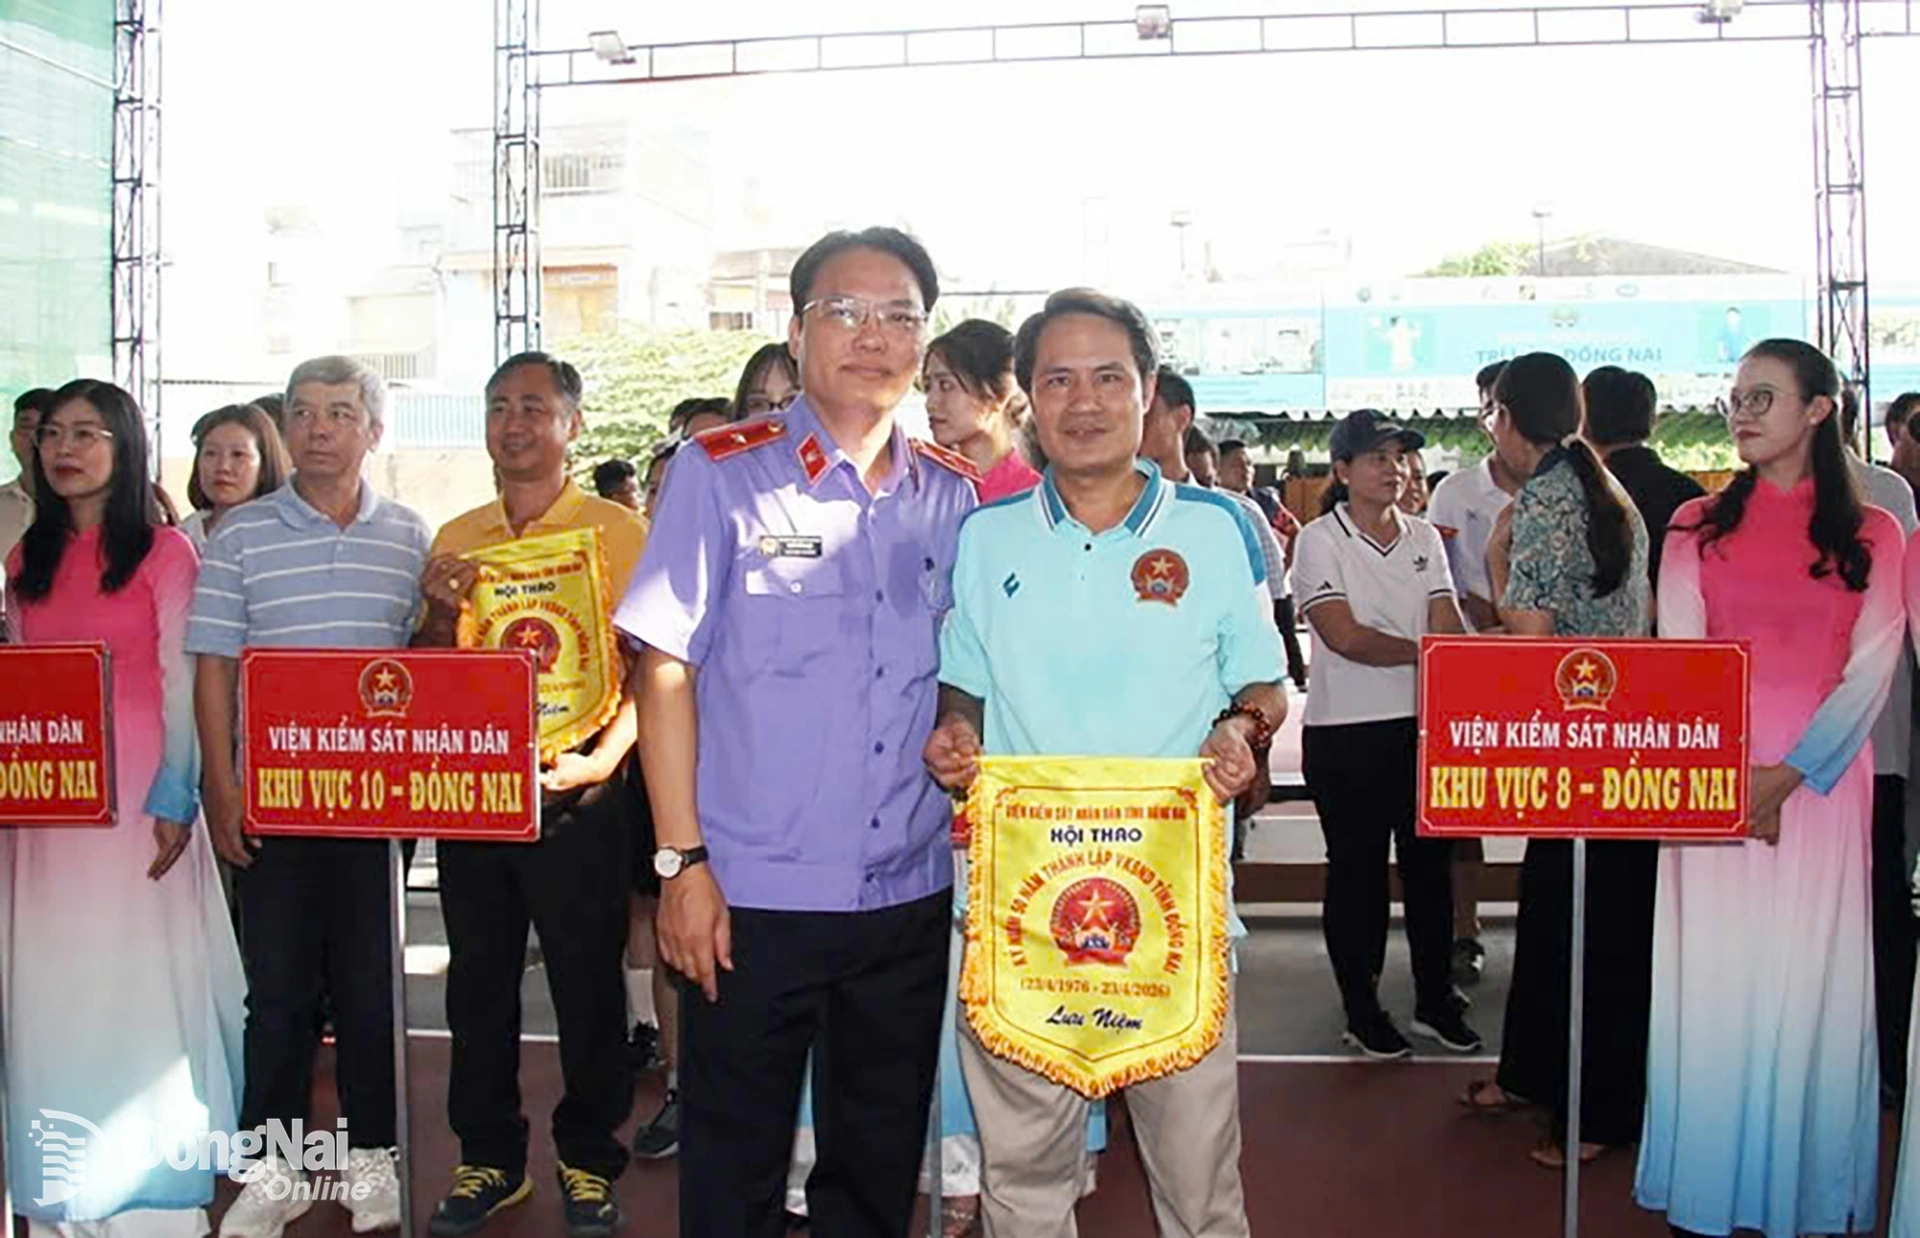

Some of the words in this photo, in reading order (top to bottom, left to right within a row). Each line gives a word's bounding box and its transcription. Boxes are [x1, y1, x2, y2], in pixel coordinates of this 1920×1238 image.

[1627, 349, 1662, 363] NAI
[47, 713, 83, 744] DÂN
[269, 720, 311, 758] VIỆN
[317, 715, 366, 752] KIỂM
[371, 721, 406, 753] SÁT
[412, 722, 464, 753] NHÂN
[470, 723, 510, 754] DÂN
[1449, 715, 1498, 755] VIỆN
[1505, 709, 1560, 748] KIỂM
[1566, 715, 1607, 748] SÁT
[1613, 717, 1670, 749] NHÂN
[1677, 717, 1720, 749] DÂN
[60, 761, 97, 800] NAI
[258, 768, 303, 808] KHU
[308, 769, 352, 819] VỰC
[360, 770, 386, 810] 10
[391, 785, 404, 797] -
[410, 756, 475, 812] ĐỒNG
[481, 772, 524, 813] NAI
[1430, 766, 1487, 809] KHU
[1495, 766, 1549, 819] VỰC
[1556, 767, 1572, 810] 8
[1579, 782, 1595, 795] -
[1602, 751, 1681, 811] ĐỒNG
[1688, 768, 1738, 811] NAI
[1051, 825, 1083, 847] HỘI
[1090, 828, 1143, 843] THAO
[1045, 1005, 1086, 1027] Lưu
[1091, 1007, 1143, 1034] Niệm
